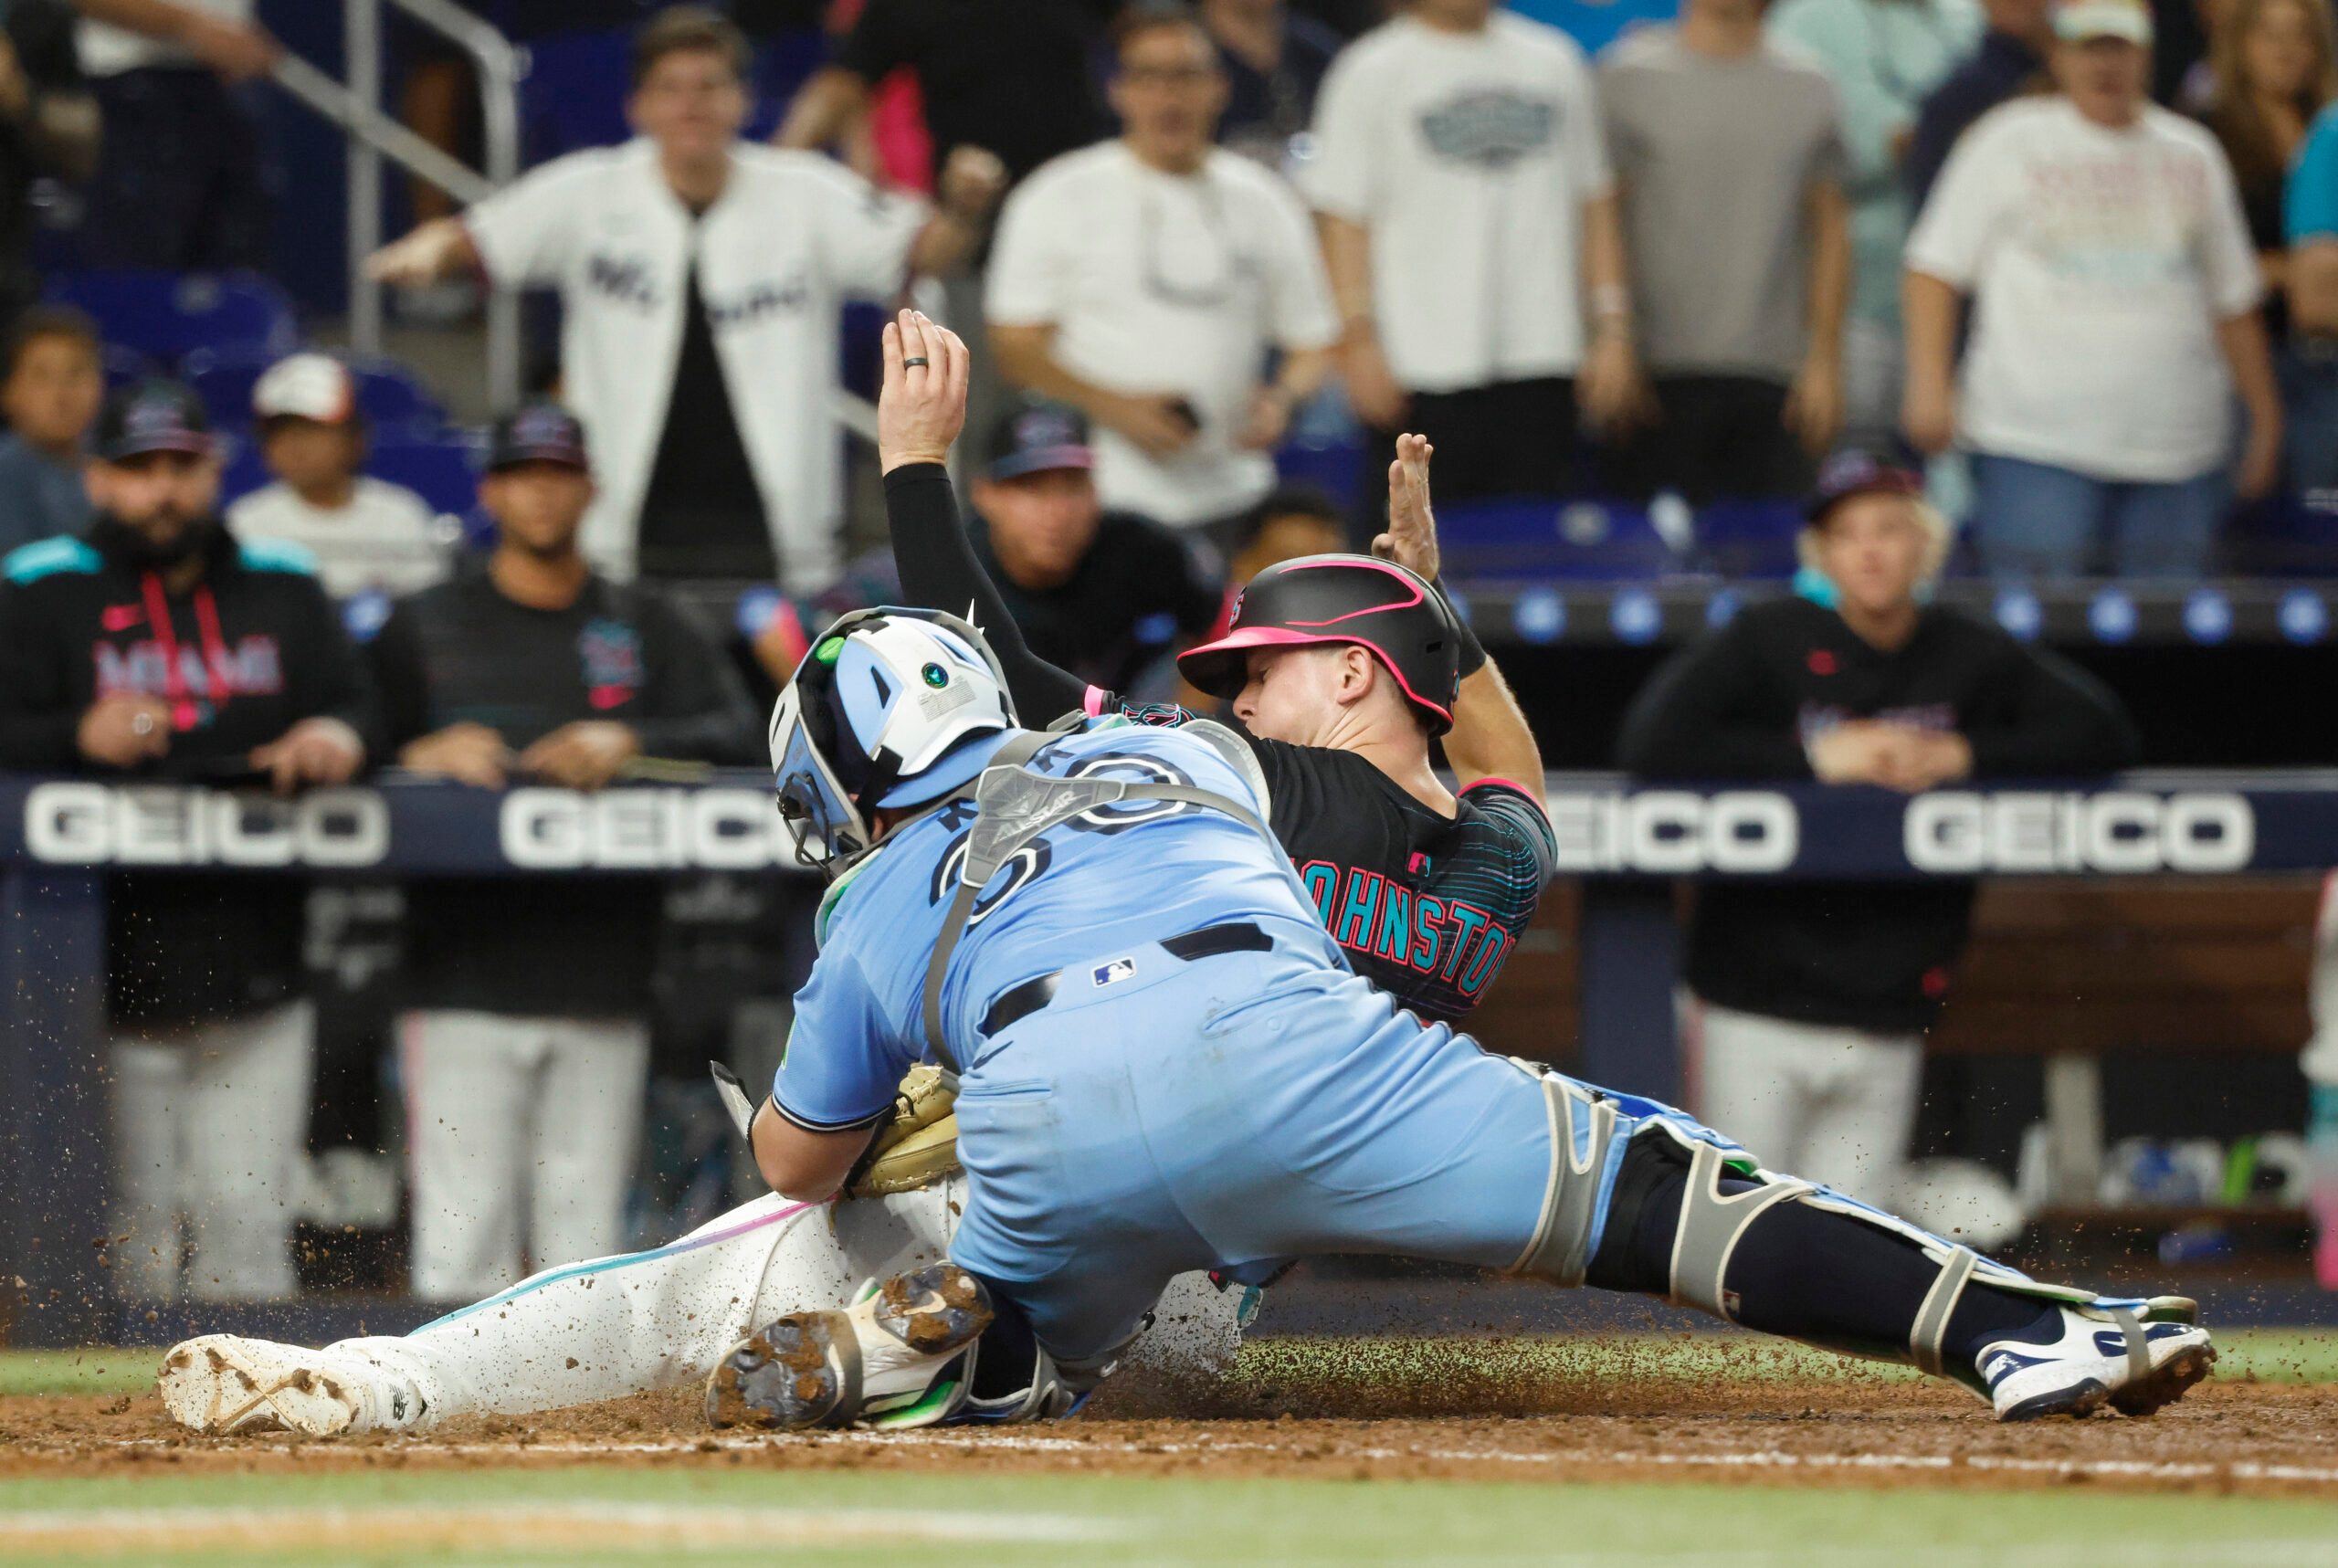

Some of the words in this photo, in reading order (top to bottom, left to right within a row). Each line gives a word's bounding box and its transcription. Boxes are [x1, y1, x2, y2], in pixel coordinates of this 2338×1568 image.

[25, 782, 393, 868] GEICO
[1543, 788, 1800, 873] EICO
[1902, 789, 2256, 873] GEICO
[1290, 857, 1517, 1005] OHNSTO
